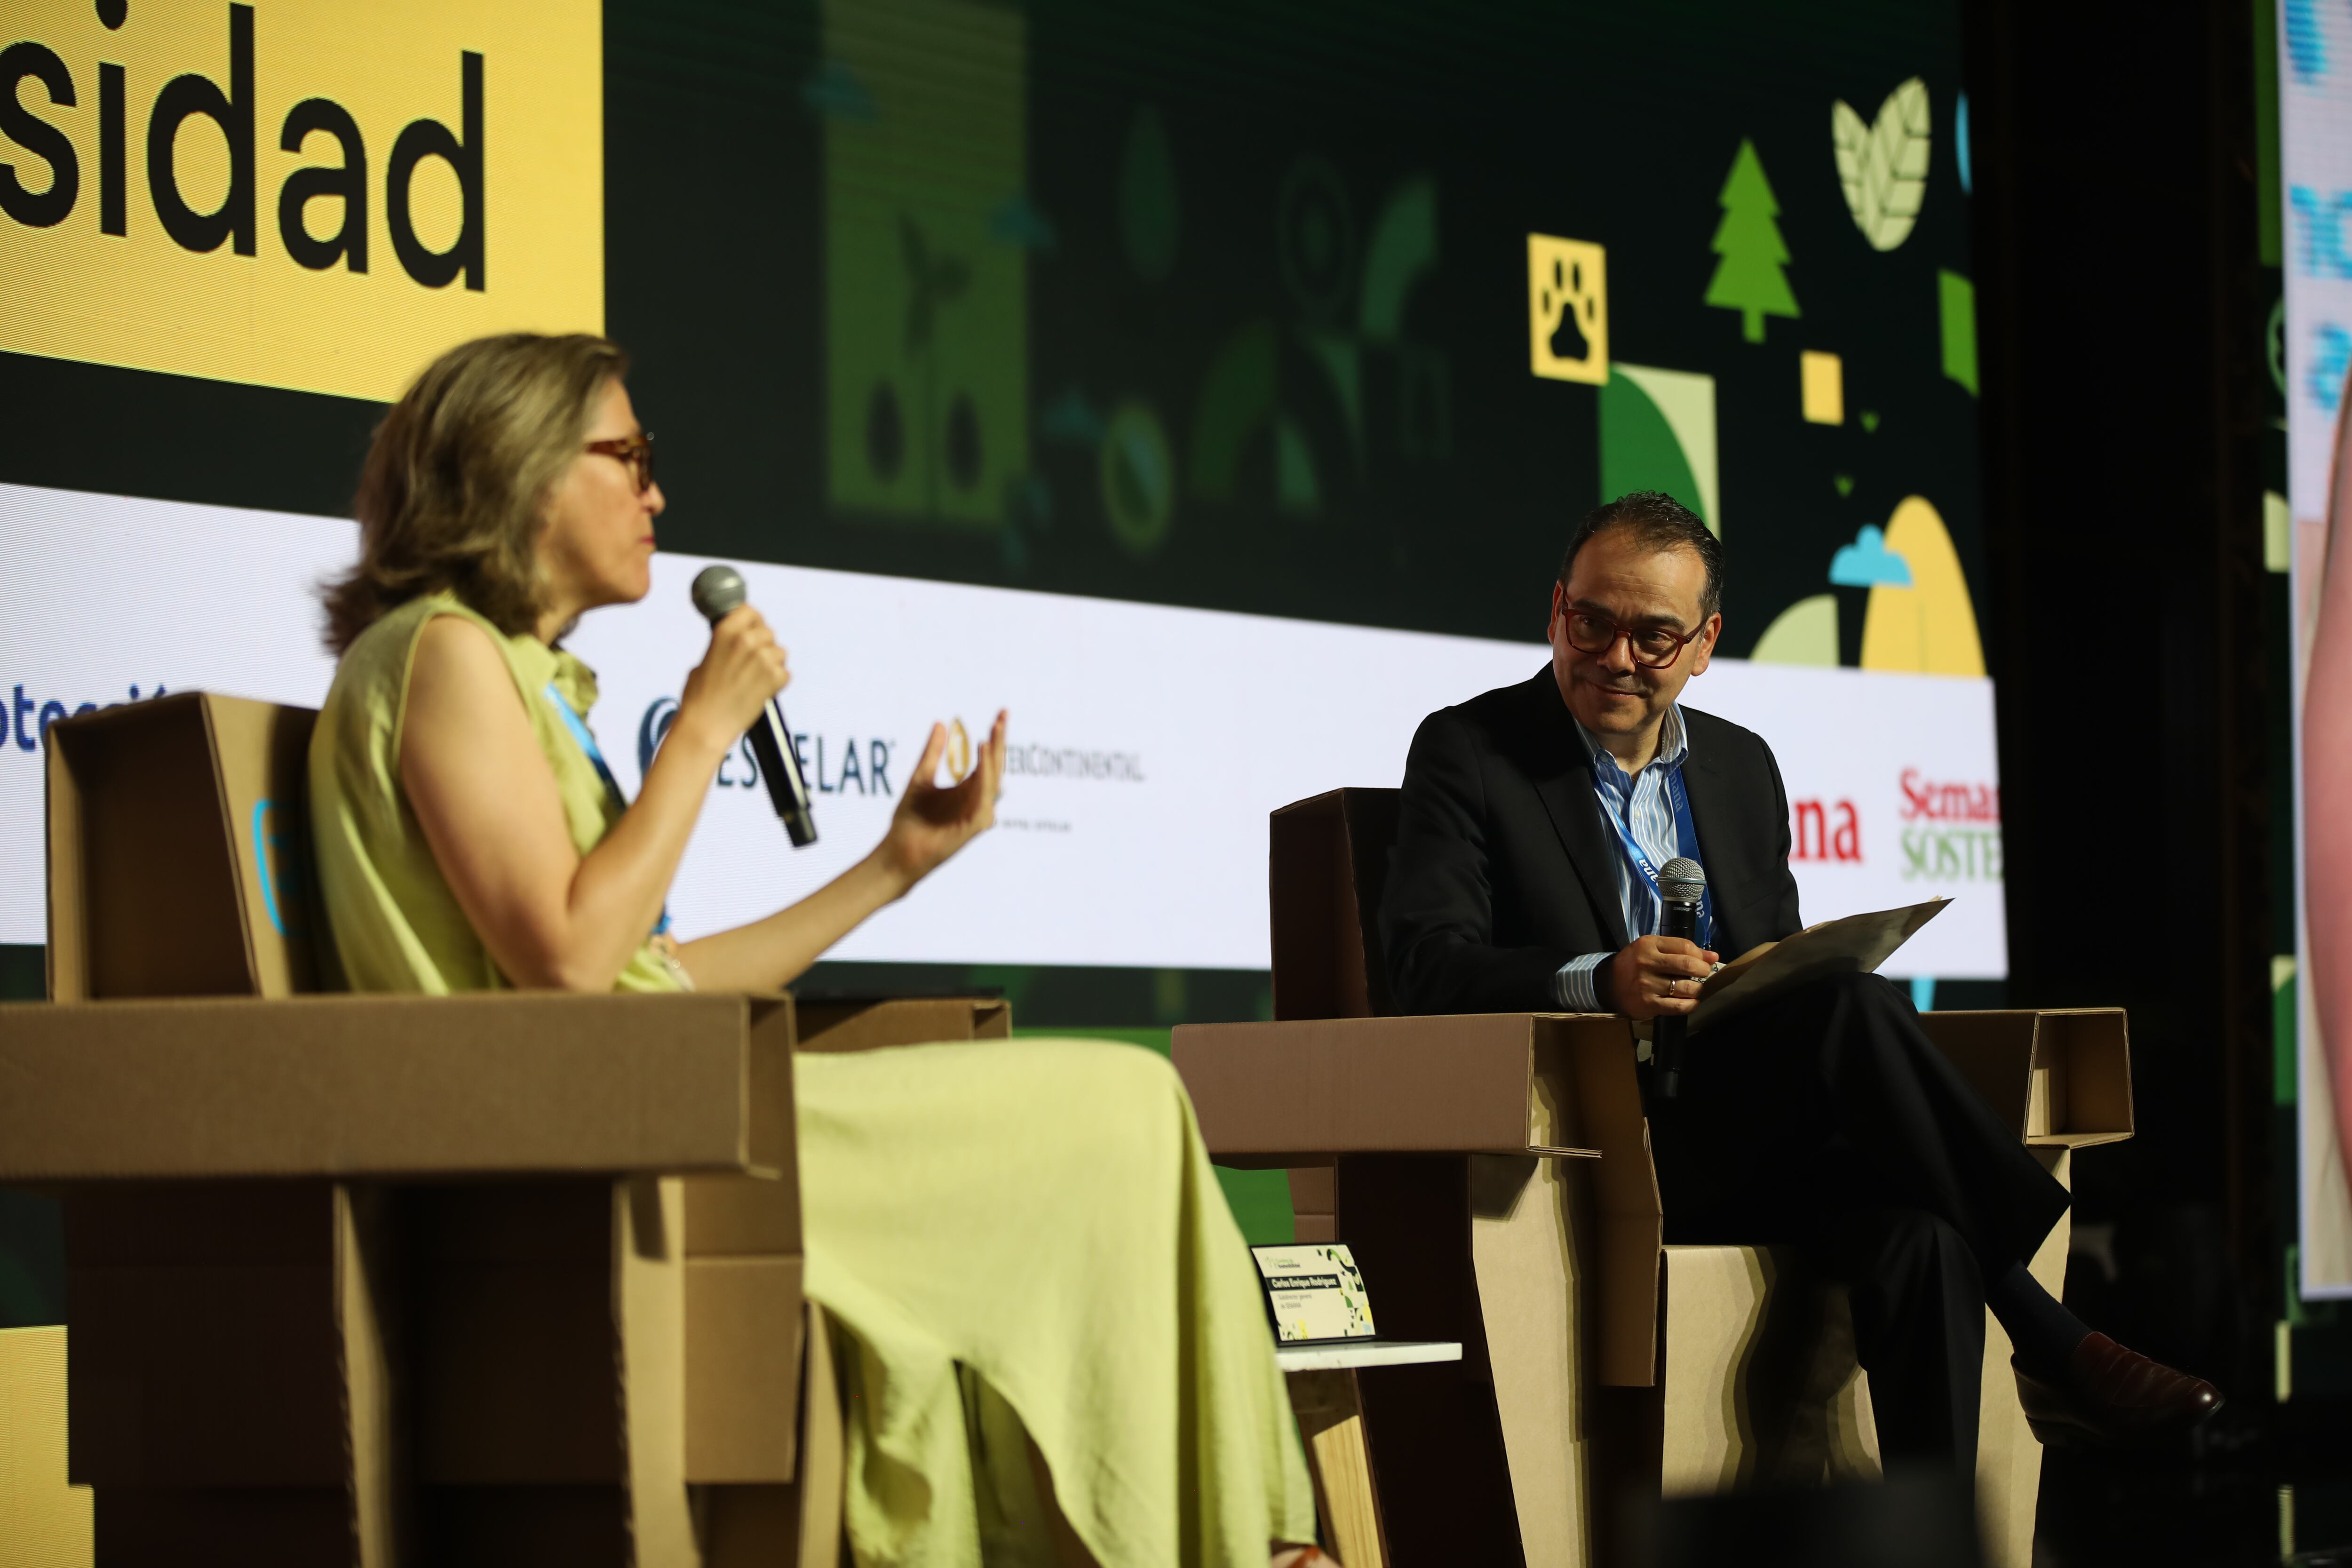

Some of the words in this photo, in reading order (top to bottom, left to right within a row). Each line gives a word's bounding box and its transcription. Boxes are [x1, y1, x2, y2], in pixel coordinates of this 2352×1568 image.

[0, 0, 486, 293] sidad
[717, 733, 893, 796] ESELAR
[1900, 769, 2001, 820] Sema
[1794, 798, 1863, 862] na
[1271, 1278, 1291, 1288] Carlos
[1288, 1277, 1311, 1289] Enrique
